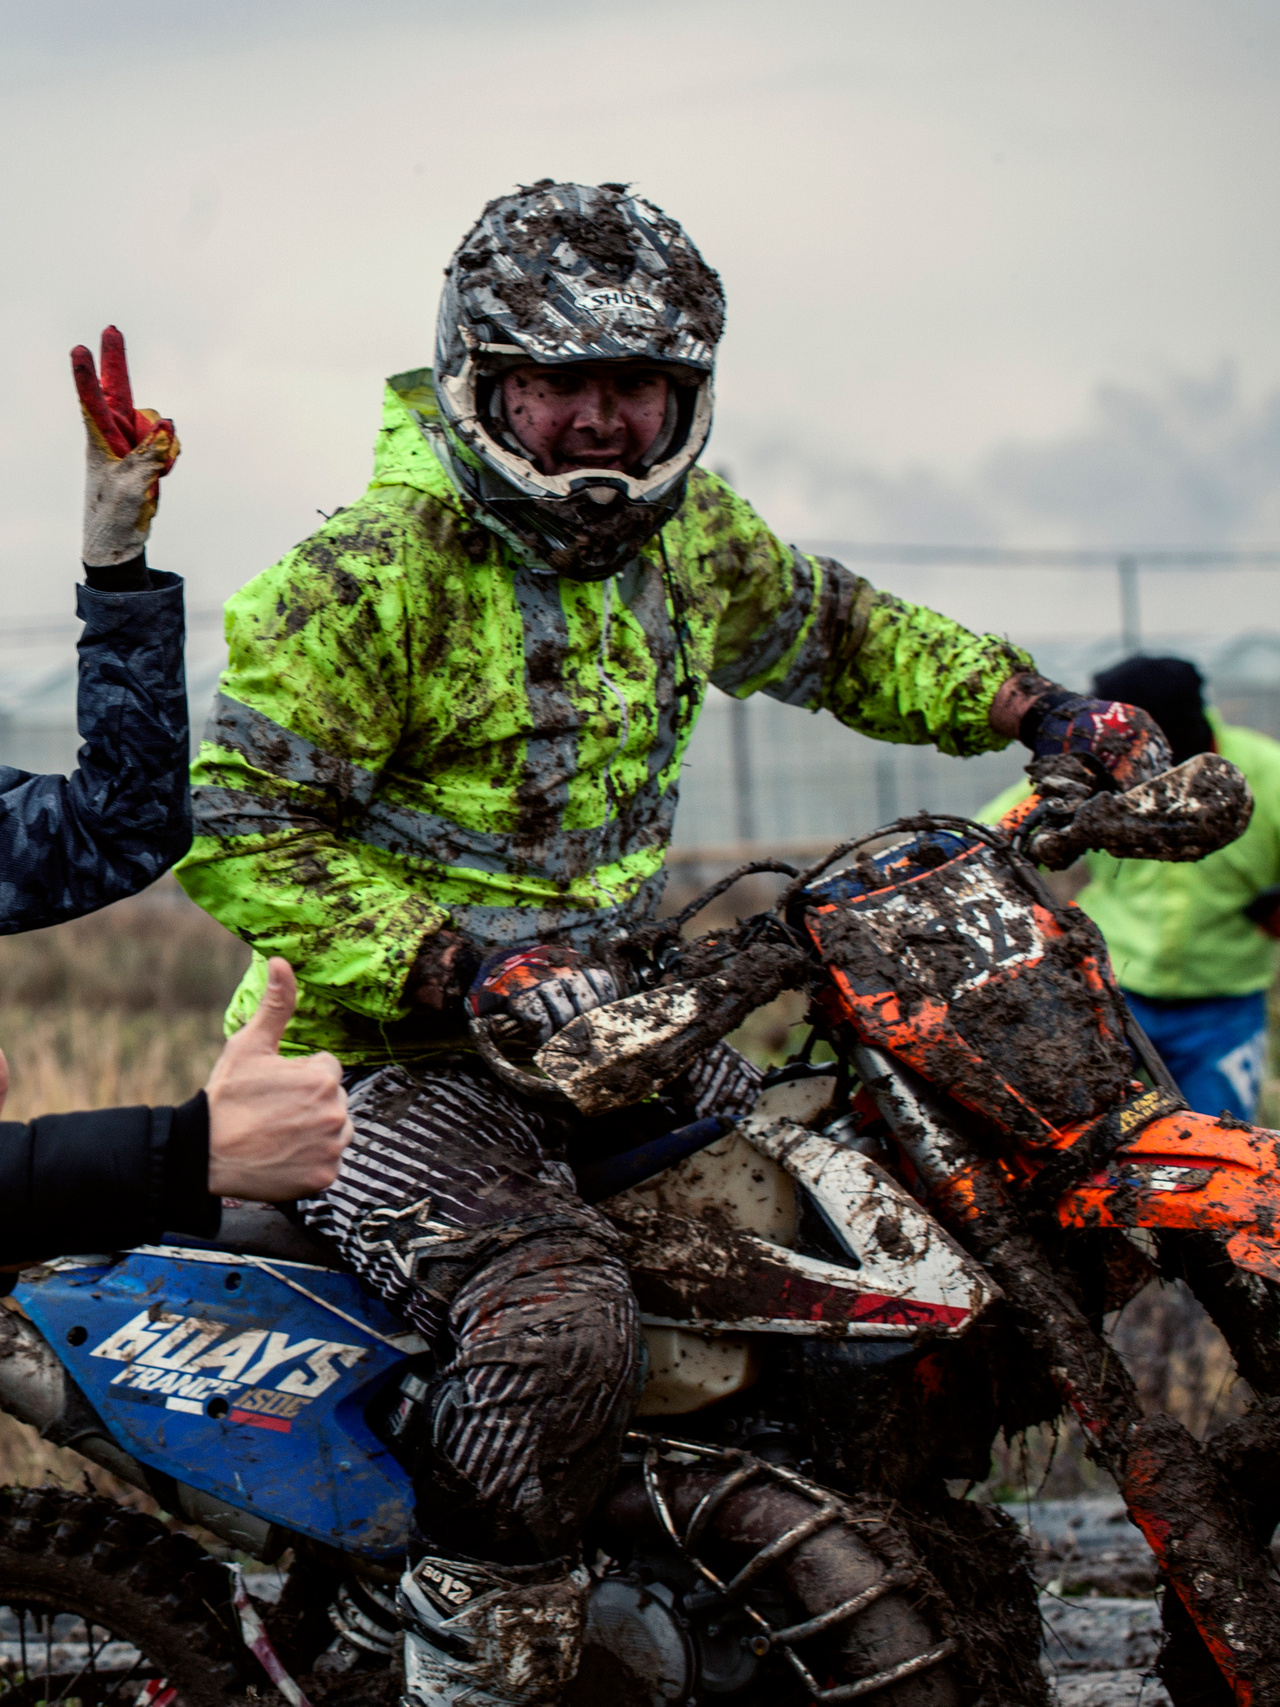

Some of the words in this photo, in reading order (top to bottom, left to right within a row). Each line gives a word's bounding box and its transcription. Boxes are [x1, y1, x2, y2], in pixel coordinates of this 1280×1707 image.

[591, 292, 651, 308] SHO
[89, 1310, 369, 1398] 6DAYS
[110, 1364, 243, 1400] FRANCE
